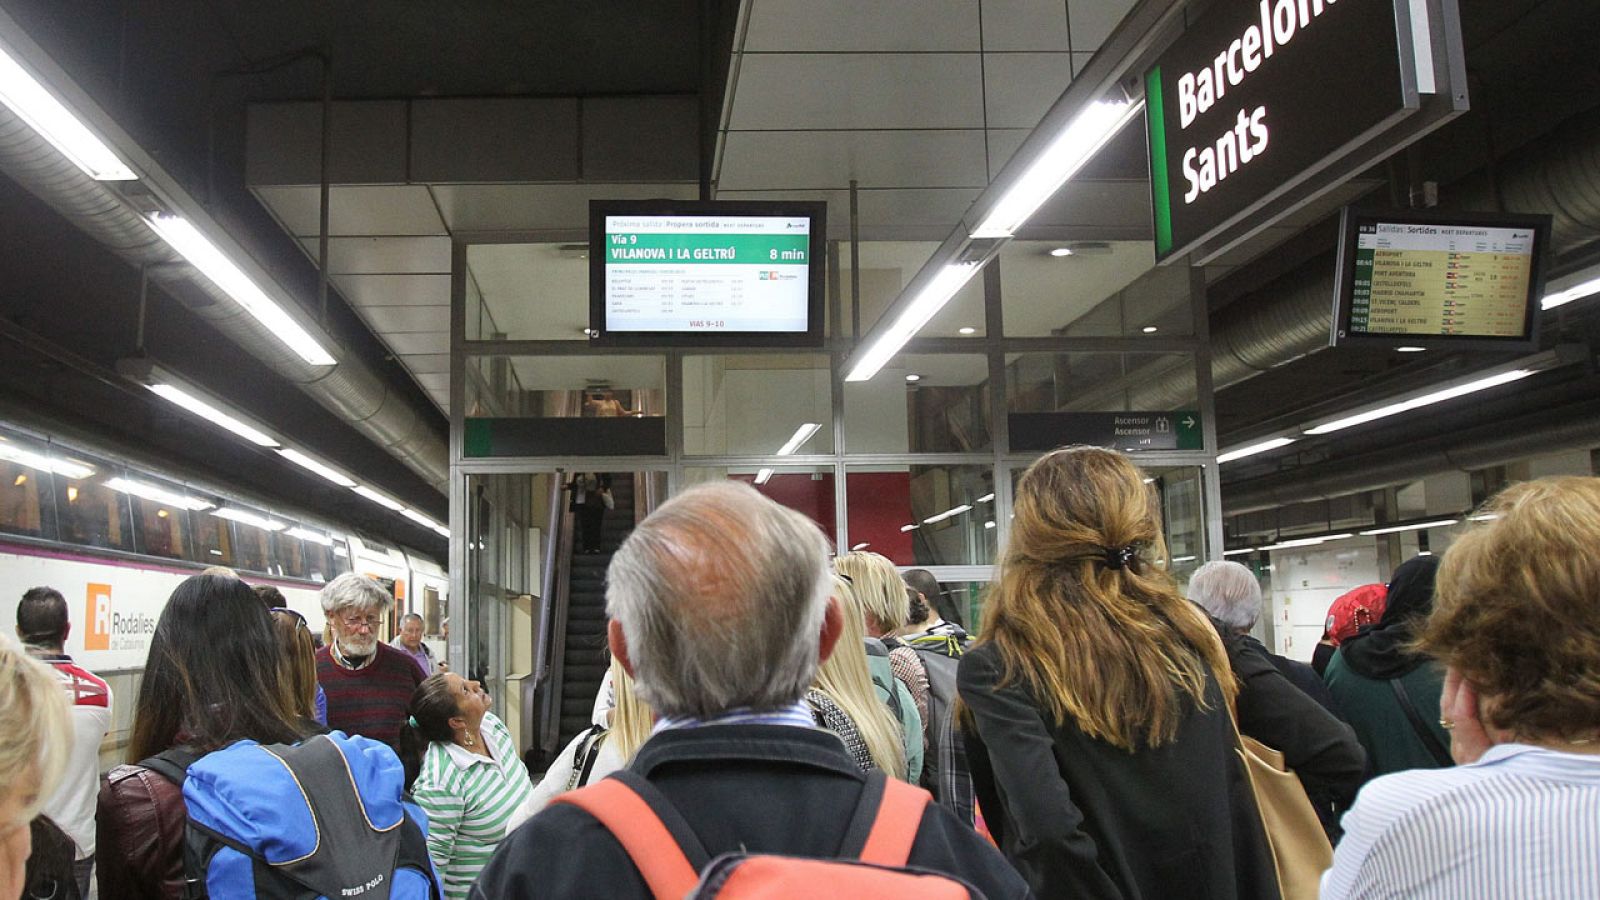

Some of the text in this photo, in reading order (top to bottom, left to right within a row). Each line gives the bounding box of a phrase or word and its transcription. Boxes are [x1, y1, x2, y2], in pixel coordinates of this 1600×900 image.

[1178, 0, 1337, 129] Barcelo
[1182, 106, 1268, 204] Sants
[1378, 225, 1403, 233] Salidas
[1408, 226, 1437, 234] Sortides
[611, 234, 637, 245] Vía 9
[611, 246, 805, 260] VILANOVA I LA GELTRÚ 8 min
[706, 320, 724, 328] 9-10
[1114, 416, 1149, 425] Ascensor
[1114, 427, 1150, 436] Ascensor
[94, 593, 110, 635] R
[113, 612, 154, 635] Rodalies
[341, 873, 384, 896] SWISS POLO
